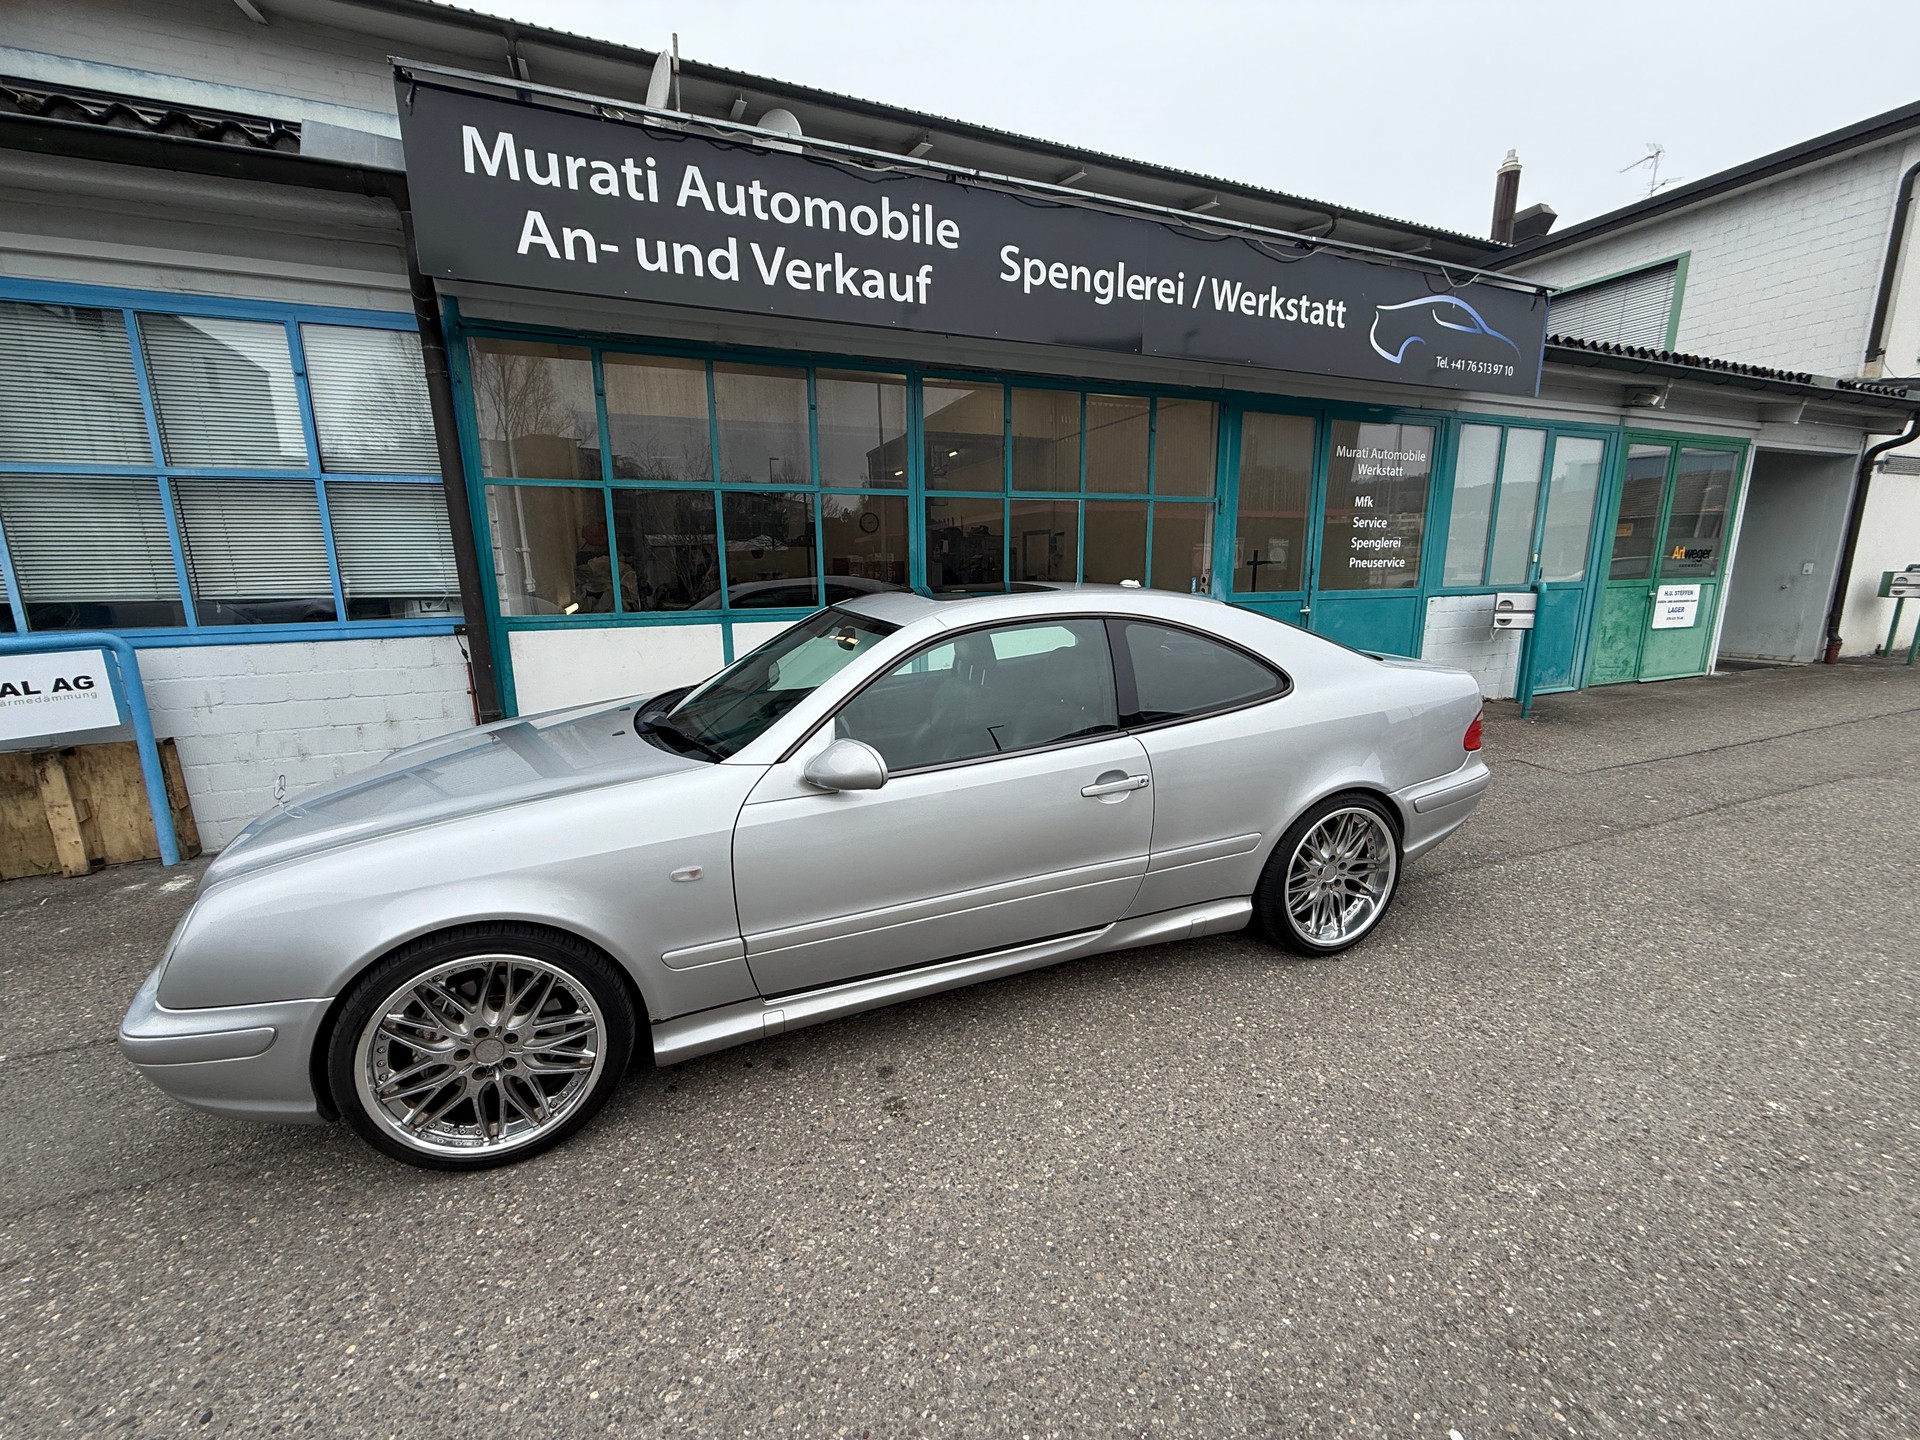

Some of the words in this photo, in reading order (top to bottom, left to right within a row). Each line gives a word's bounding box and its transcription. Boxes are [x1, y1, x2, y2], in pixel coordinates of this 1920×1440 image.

[461, 125, 659, 203] Murati
[676, 165, 960, 250] Automobile
[516, 210, 619, 264] An-
[635, 236, 740, 282] und
[749, 243, 933, 305] Verkauf
[999, 244, 1185, 306] Spenglerei
[1192, 275, 1206, 309] /
[1211, 277, 1347, 329] Werkstatt
[1436, 356, 1449, 369] Tel.
[1450, 359, 1466, 371] +41
[1467, 360, 1477, 372] 76
[1478, 361, 1492, 374] 513
[1493, 363, 1503, 375] 97
[1504, 365, 1514, 377] 10
[1336, 445, 1369, 458] Murati
[1371, 448, 1426, 462] Automobile
[1358, 463, 1403, 477] Werkstatt
[1354, 496, 1374, 508] Mfk
[1352, 516, 1388, 529] Service
[1350, 537, 1402, 551] Spenglerei
[1349, 556, 1406, 569] Pneuservice
[52, 675, 94, 692] AG
